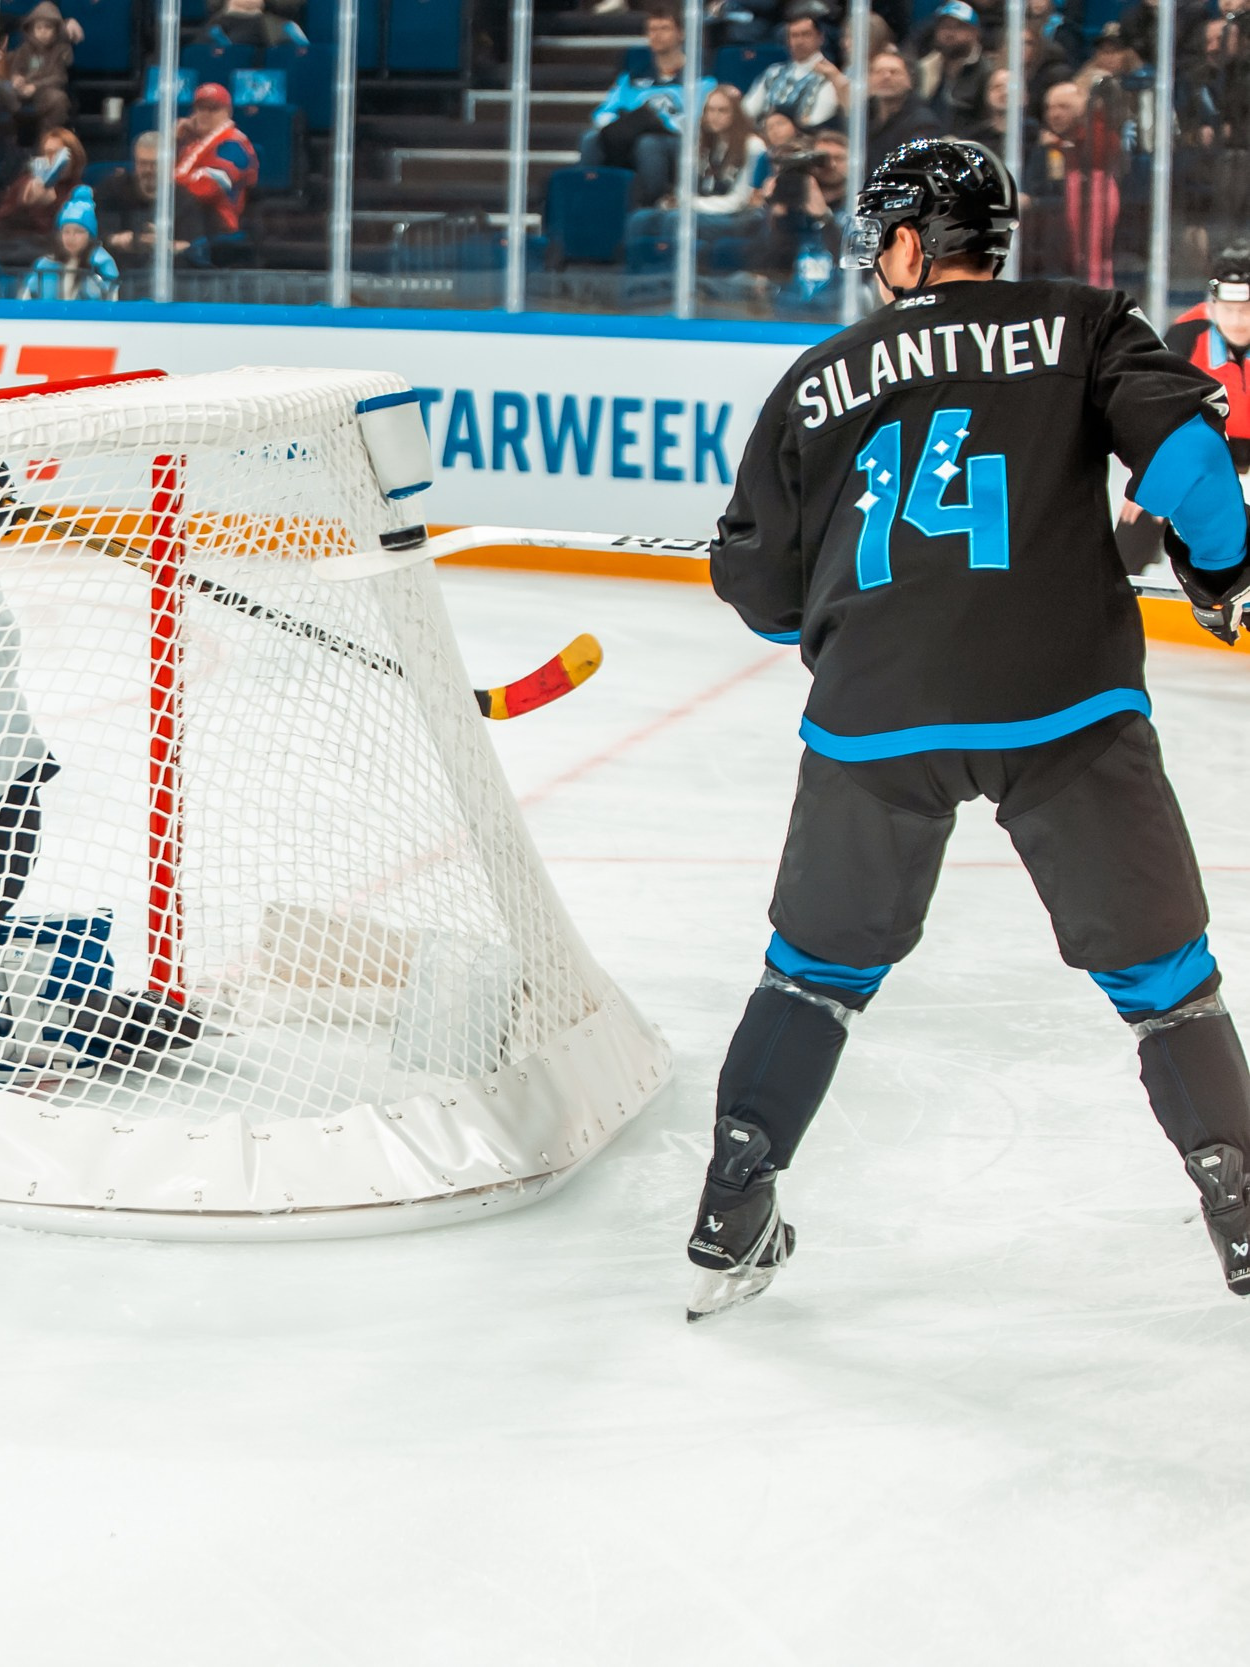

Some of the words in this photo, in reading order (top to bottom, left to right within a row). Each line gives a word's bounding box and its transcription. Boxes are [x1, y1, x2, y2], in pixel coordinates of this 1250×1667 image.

[883, 196, 914, 209] CCM
[796, 315, 1066, 430] SILANTYEV
[854, 408, 1010, 591] 14
